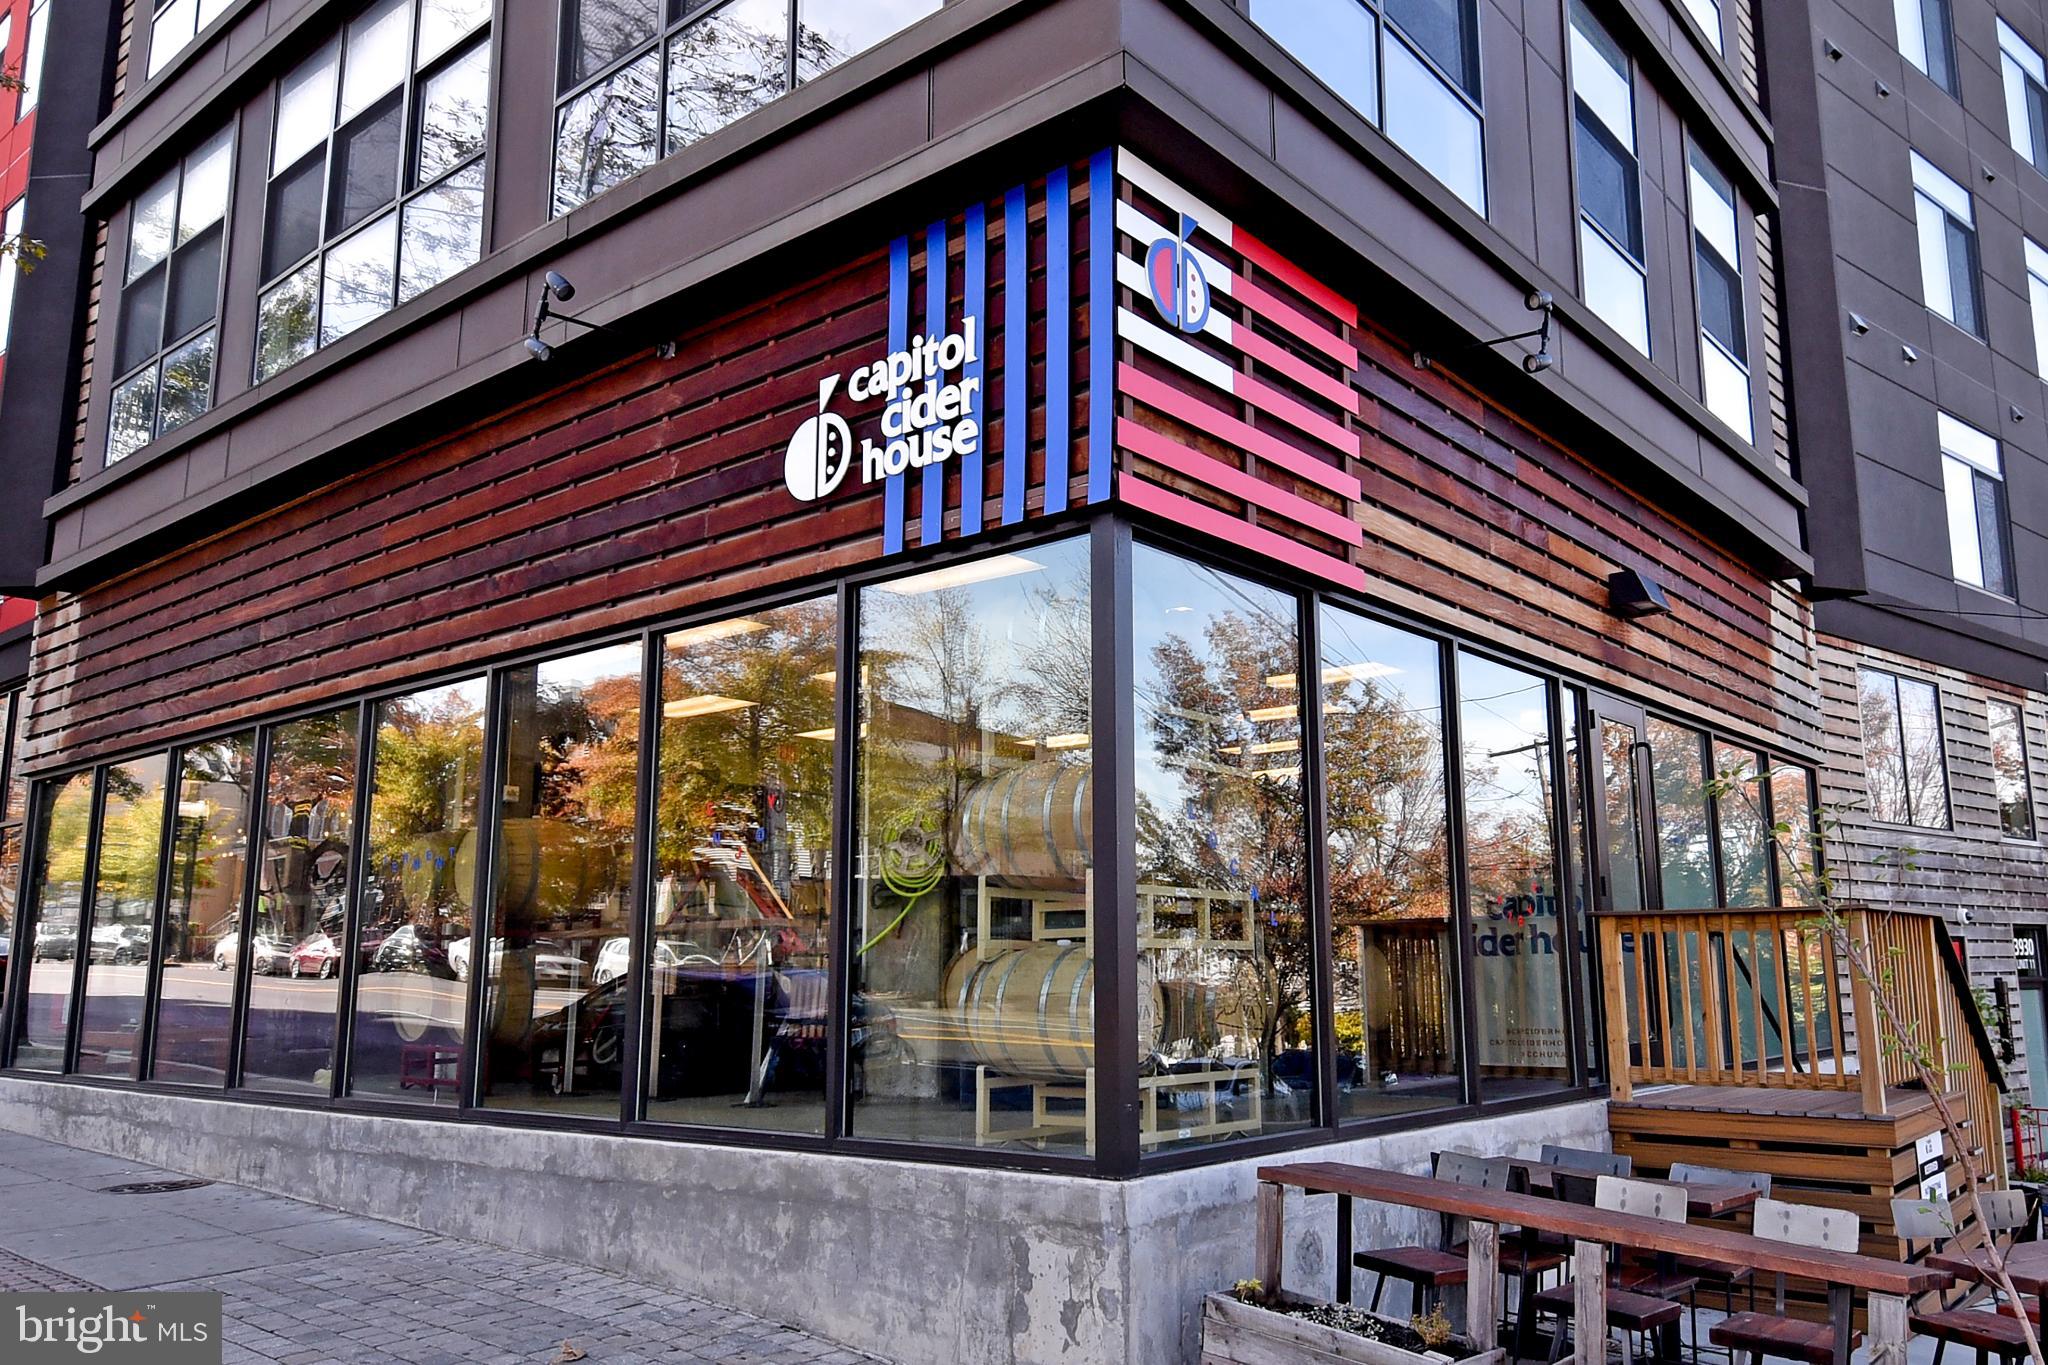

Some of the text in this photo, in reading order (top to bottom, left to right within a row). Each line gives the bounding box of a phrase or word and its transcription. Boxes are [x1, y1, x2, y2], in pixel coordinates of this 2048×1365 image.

[848, 315, 978, 402] capitol
[880, 376, 979, 438] cider
[861, 418, 979, 484] house
[2013, 937, 2035, 956] 3930
